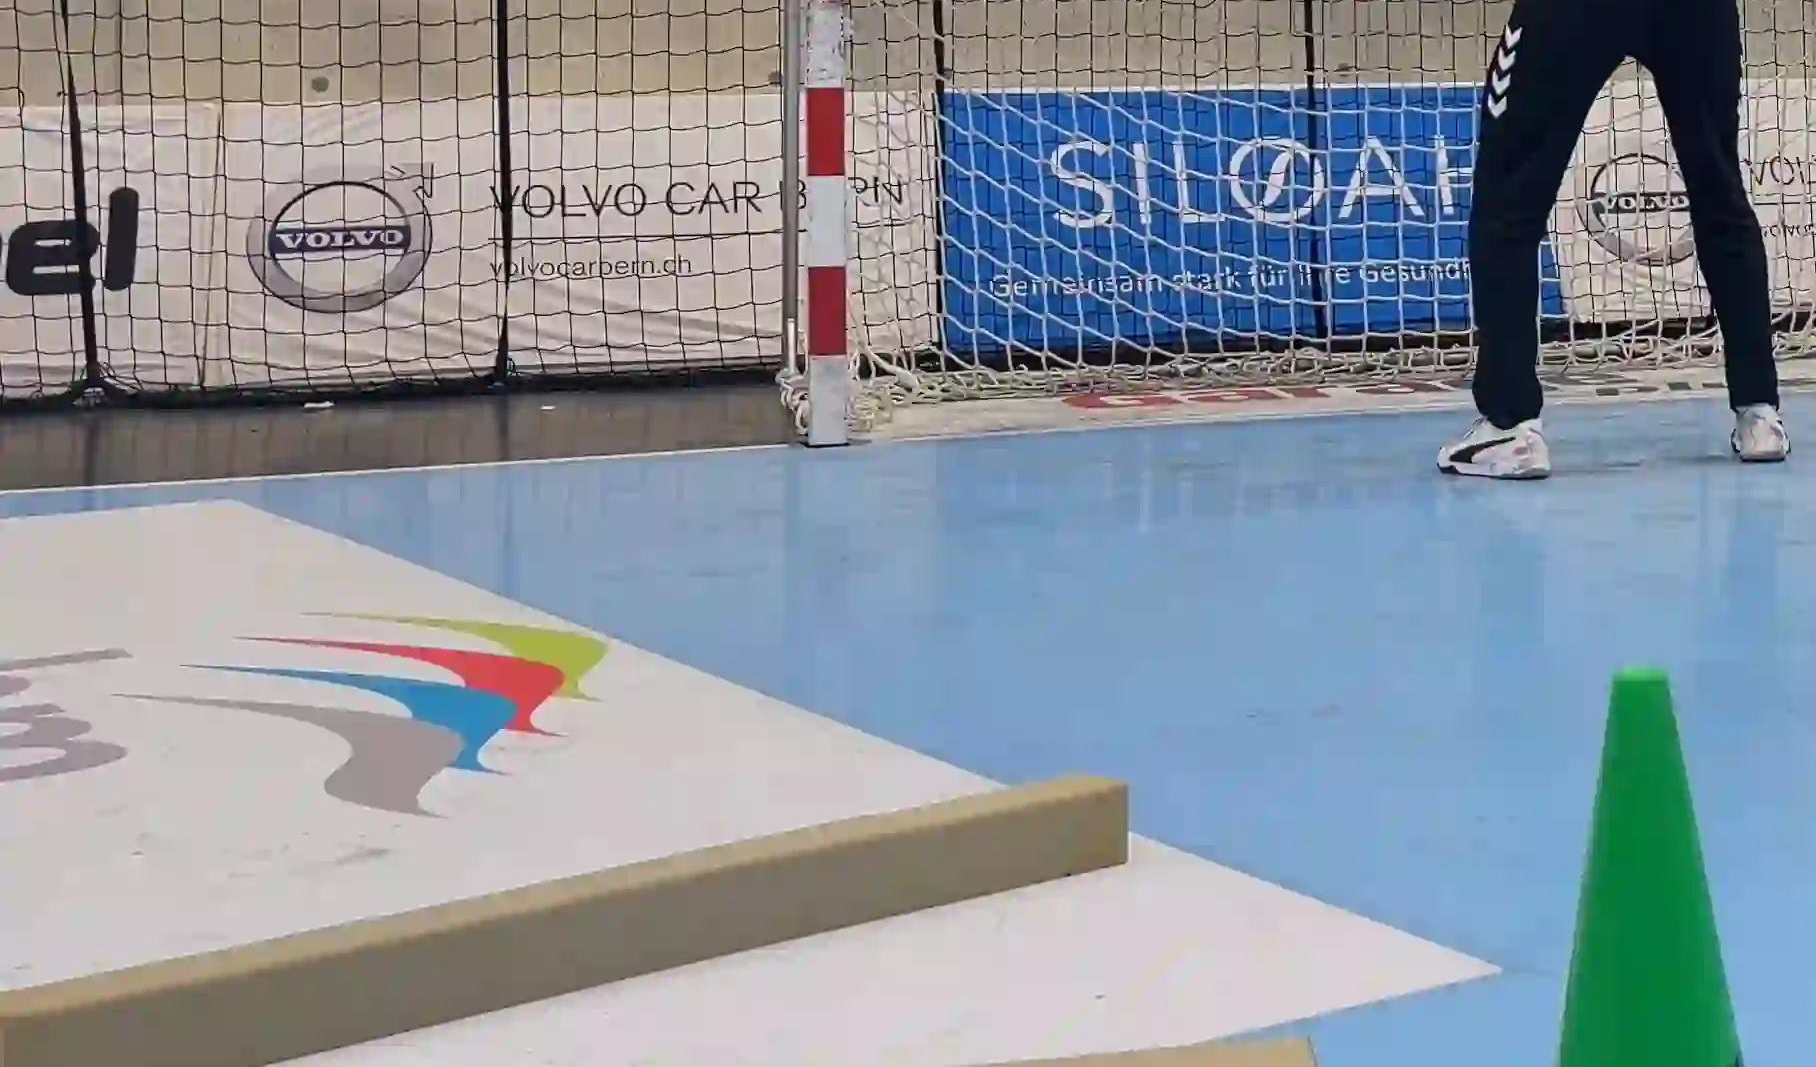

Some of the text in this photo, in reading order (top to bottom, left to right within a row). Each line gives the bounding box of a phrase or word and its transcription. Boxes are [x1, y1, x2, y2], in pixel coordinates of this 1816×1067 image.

[488, 182, 647, 218] VOLVO
[665, 181, 763, 215] CAR
[275, 230, 405, 250] VOLVO
